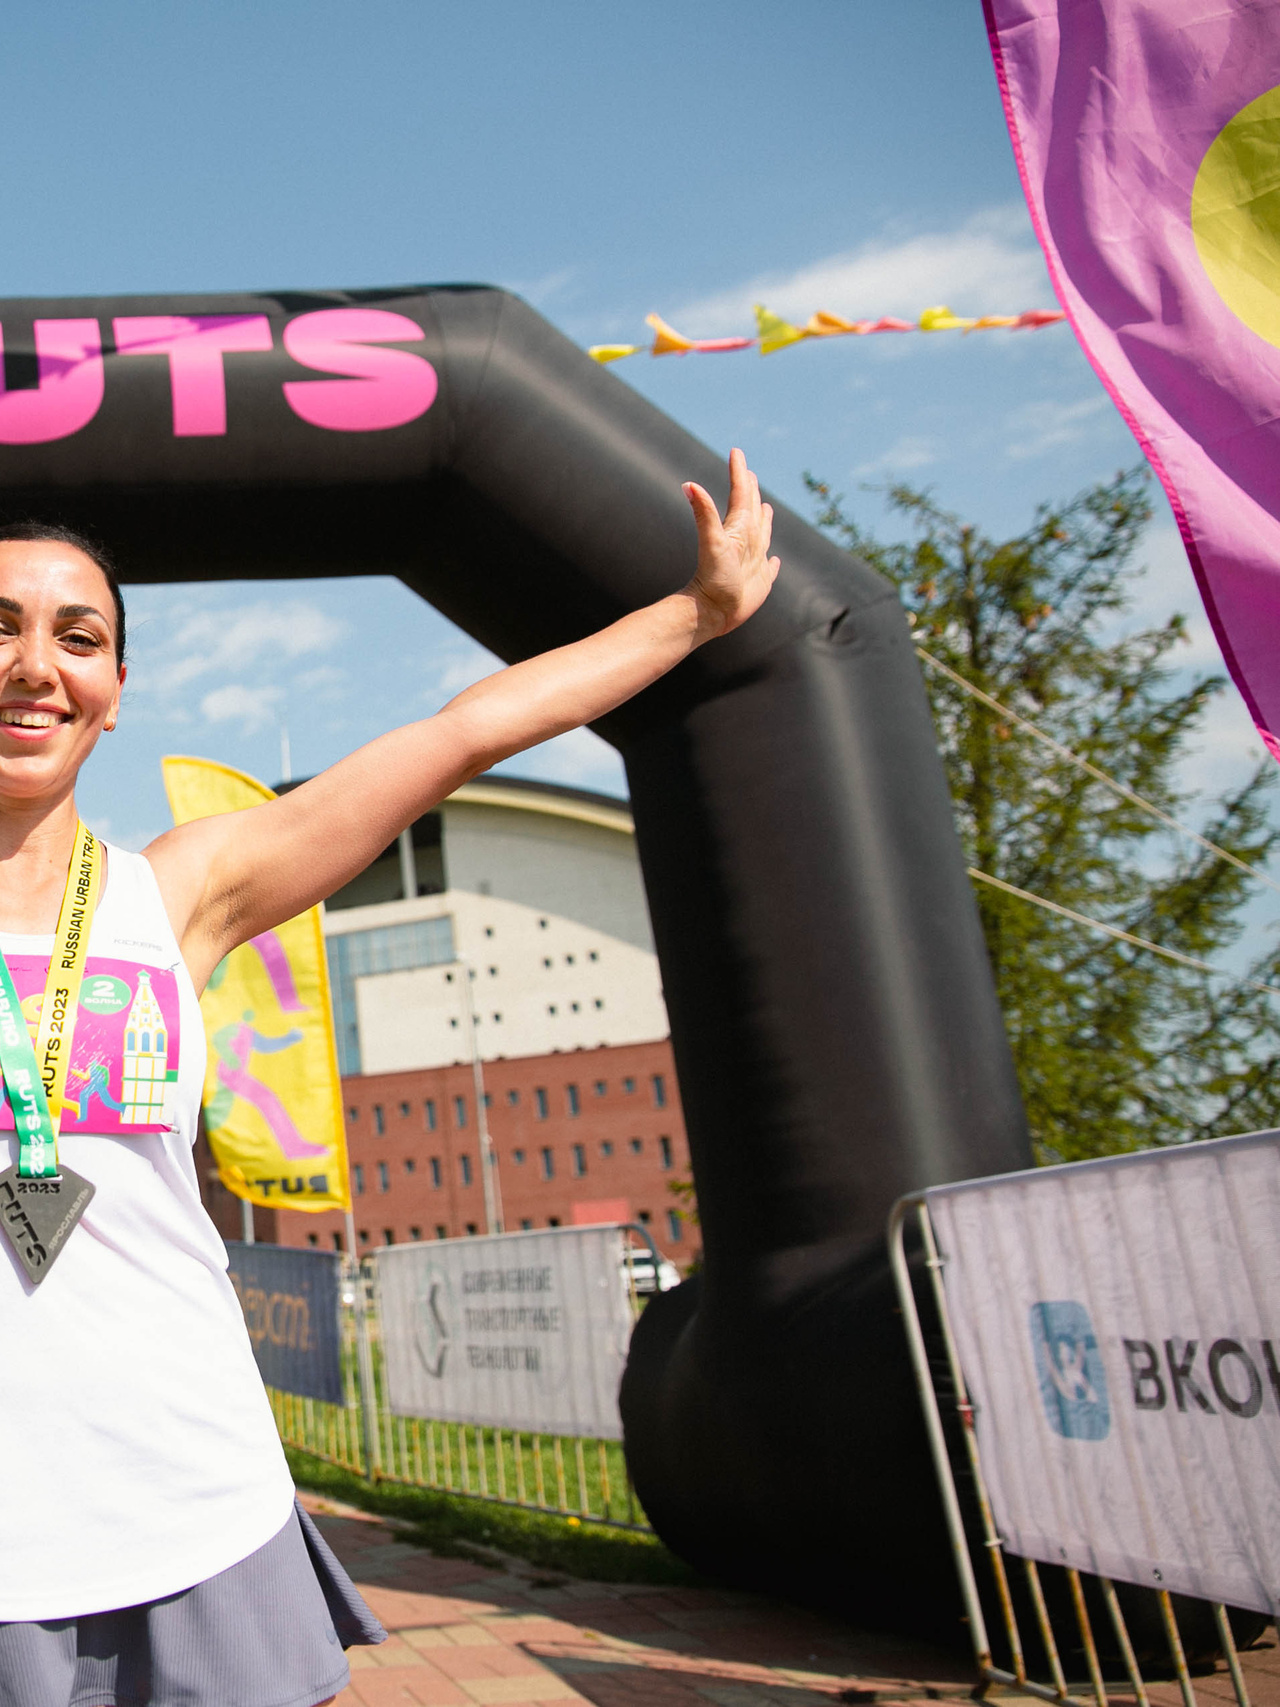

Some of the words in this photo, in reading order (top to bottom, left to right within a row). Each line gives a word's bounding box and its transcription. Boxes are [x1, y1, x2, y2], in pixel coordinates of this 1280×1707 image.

[74, 860, 93, 906] URBAN
[62, 908, 85, 969] RUSSIAN
[50, 988, 69, 1034] 2023
[92, 980, 115, 997] 2
[41, 1038, 61, 1097] RUTS
[14, 1069, 40, 1131] RUTS
[17, 1182, 61, 1194] 2023
